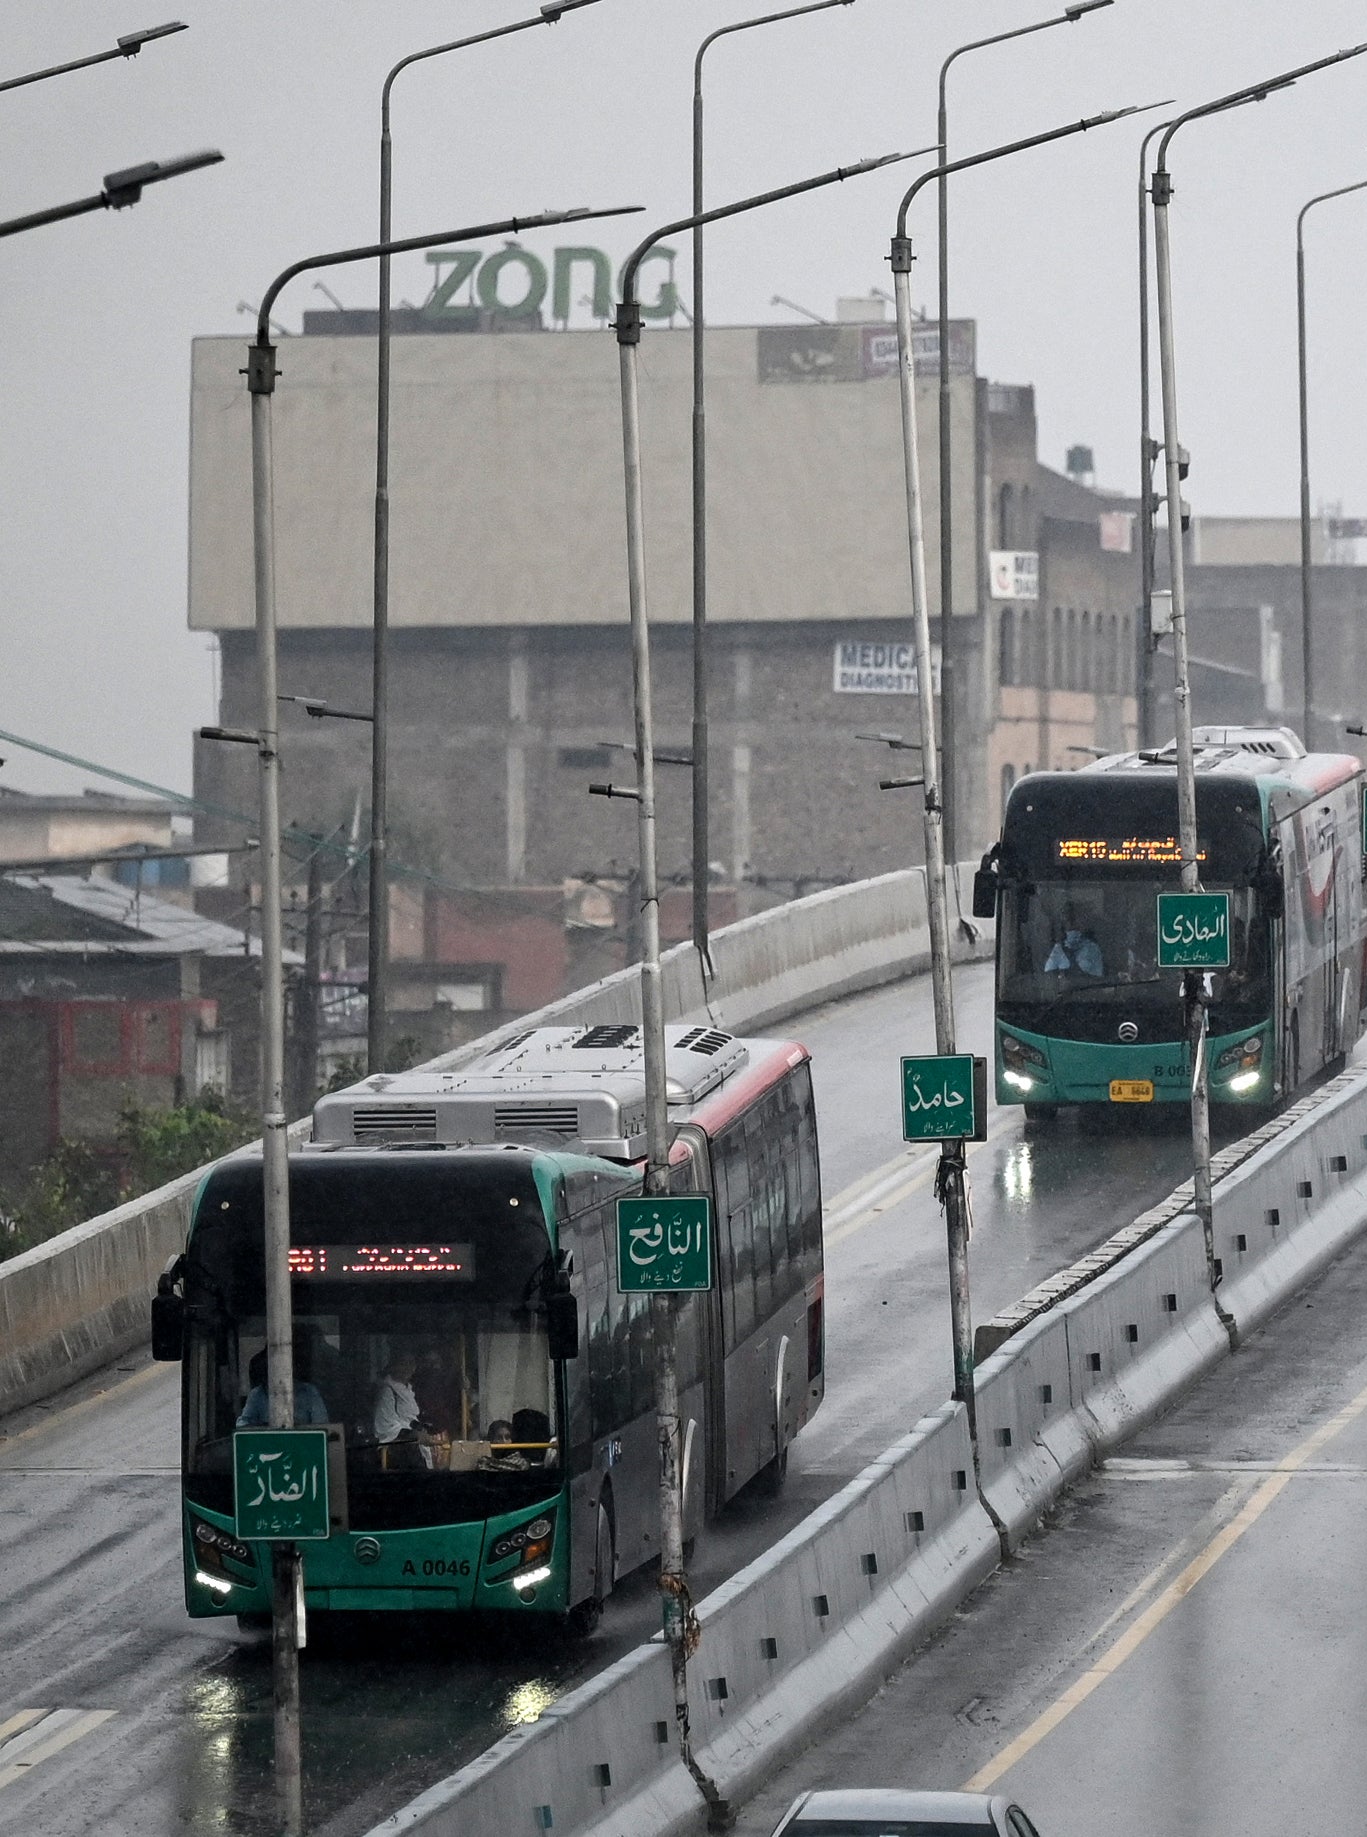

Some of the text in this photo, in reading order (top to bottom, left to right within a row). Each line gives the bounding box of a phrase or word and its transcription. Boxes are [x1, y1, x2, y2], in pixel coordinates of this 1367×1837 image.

[841, 646, 937, 669] MEDIC
[402, 1559, 471, 1576] A 0046
